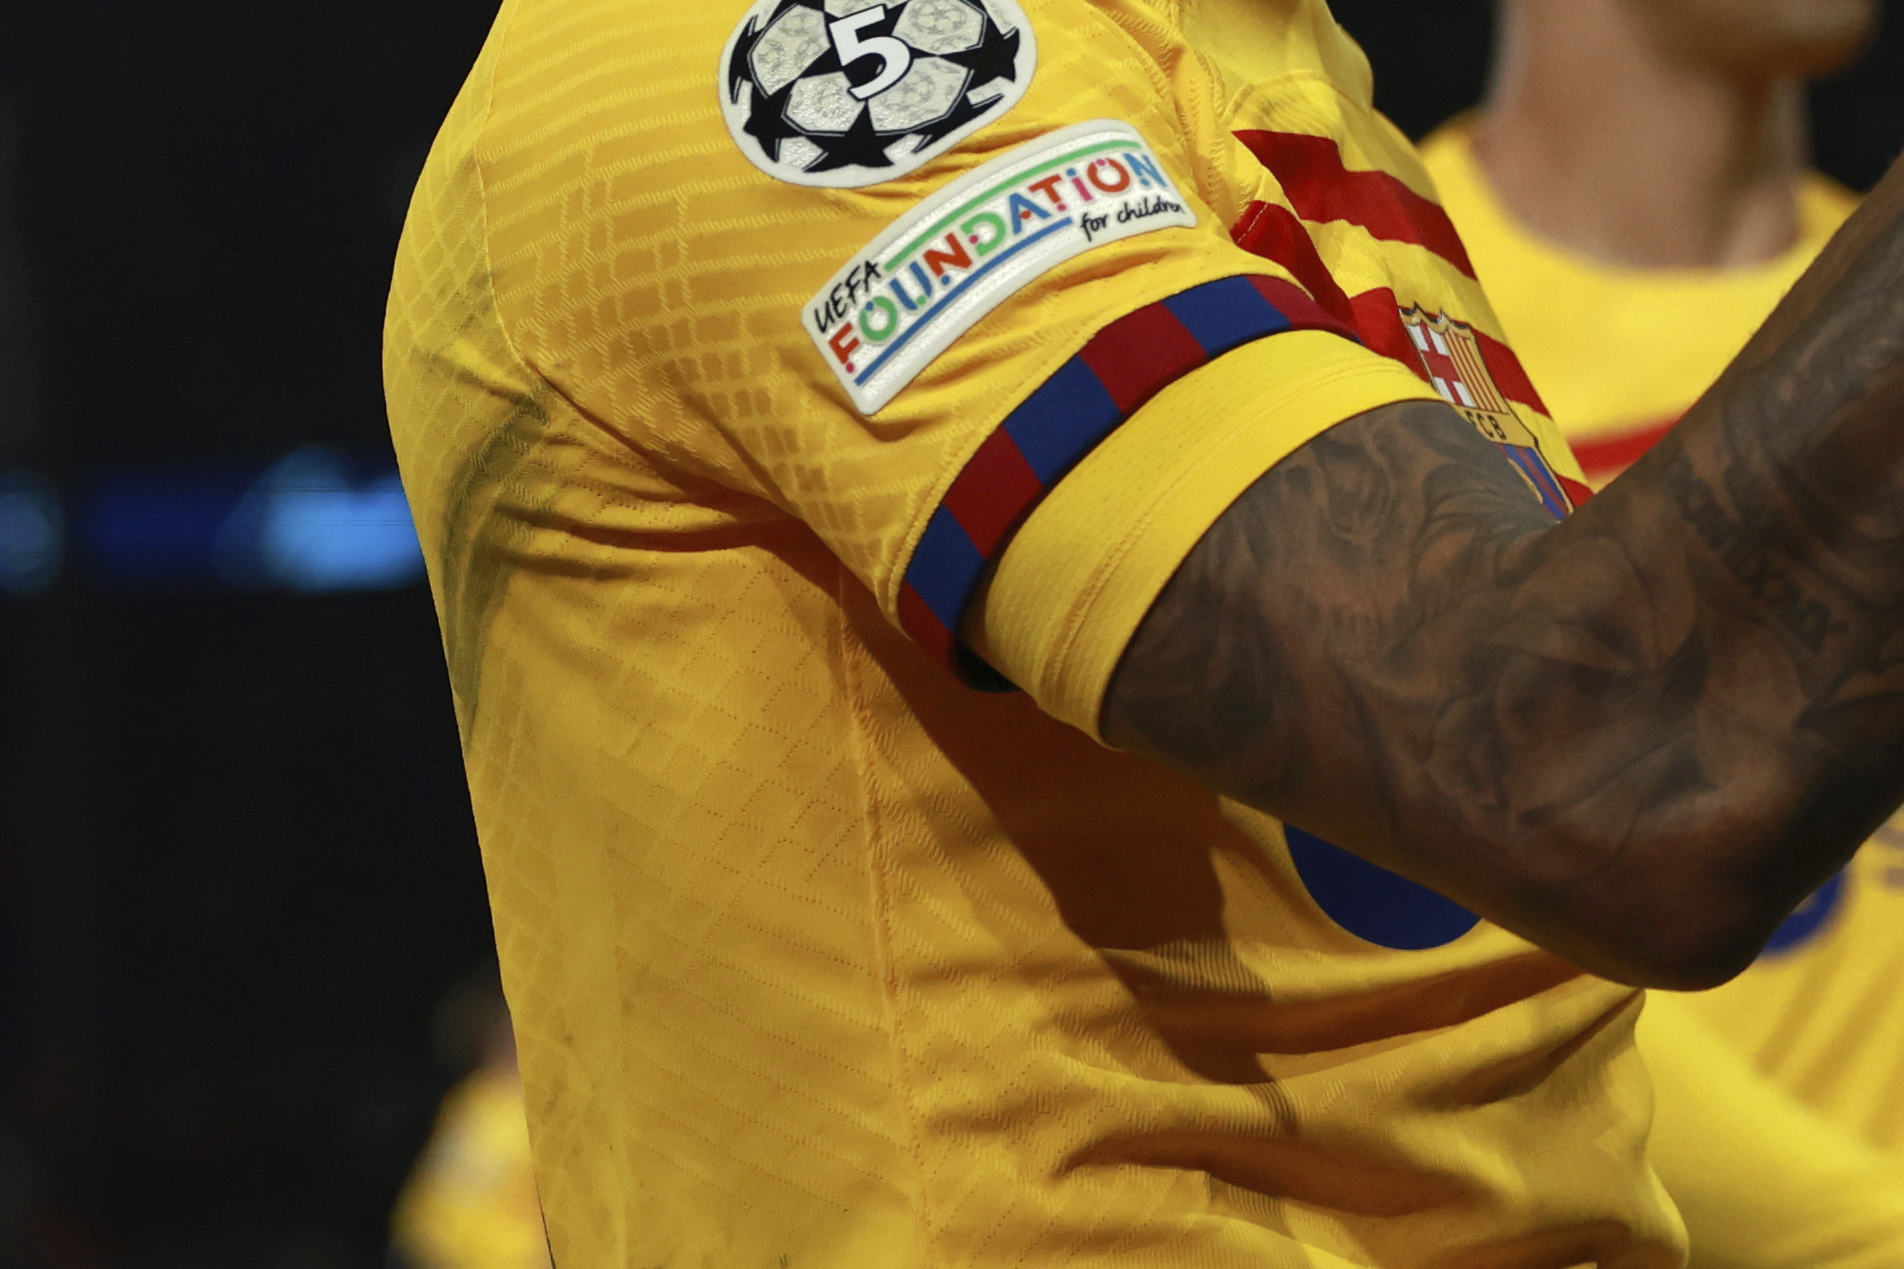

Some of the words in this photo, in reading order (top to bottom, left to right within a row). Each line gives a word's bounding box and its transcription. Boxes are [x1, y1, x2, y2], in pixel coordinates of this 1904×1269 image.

[829, 4, 911, 101] 5
[1081, 212, 1108, 242] for
[1117, 196, 1186, 223] children
[814, 260, 883, 333] UEFA
